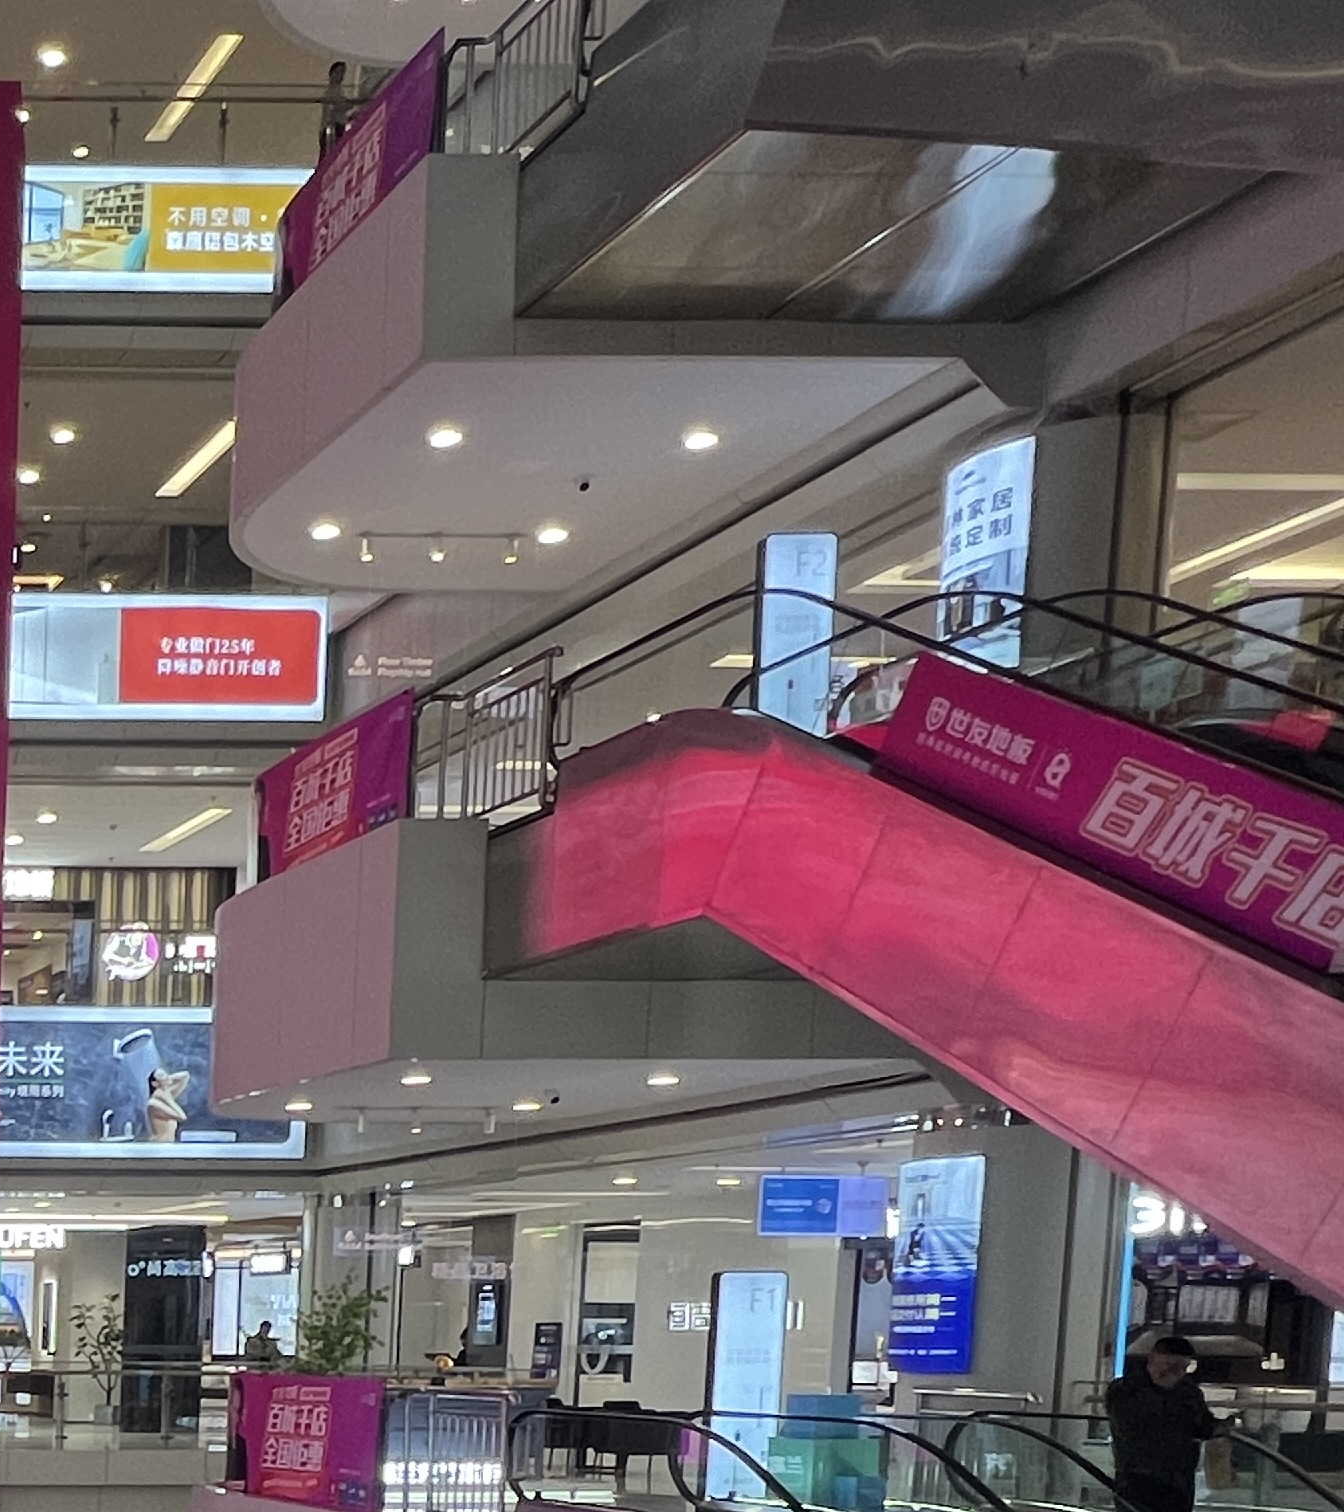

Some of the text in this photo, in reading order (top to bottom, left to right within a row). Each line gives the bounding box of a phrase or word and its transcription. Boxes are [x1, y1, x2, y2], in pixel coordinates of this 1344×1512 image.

[796, 551, 829, 577] F2
[945, 707, 1036, 766] 世友地板
